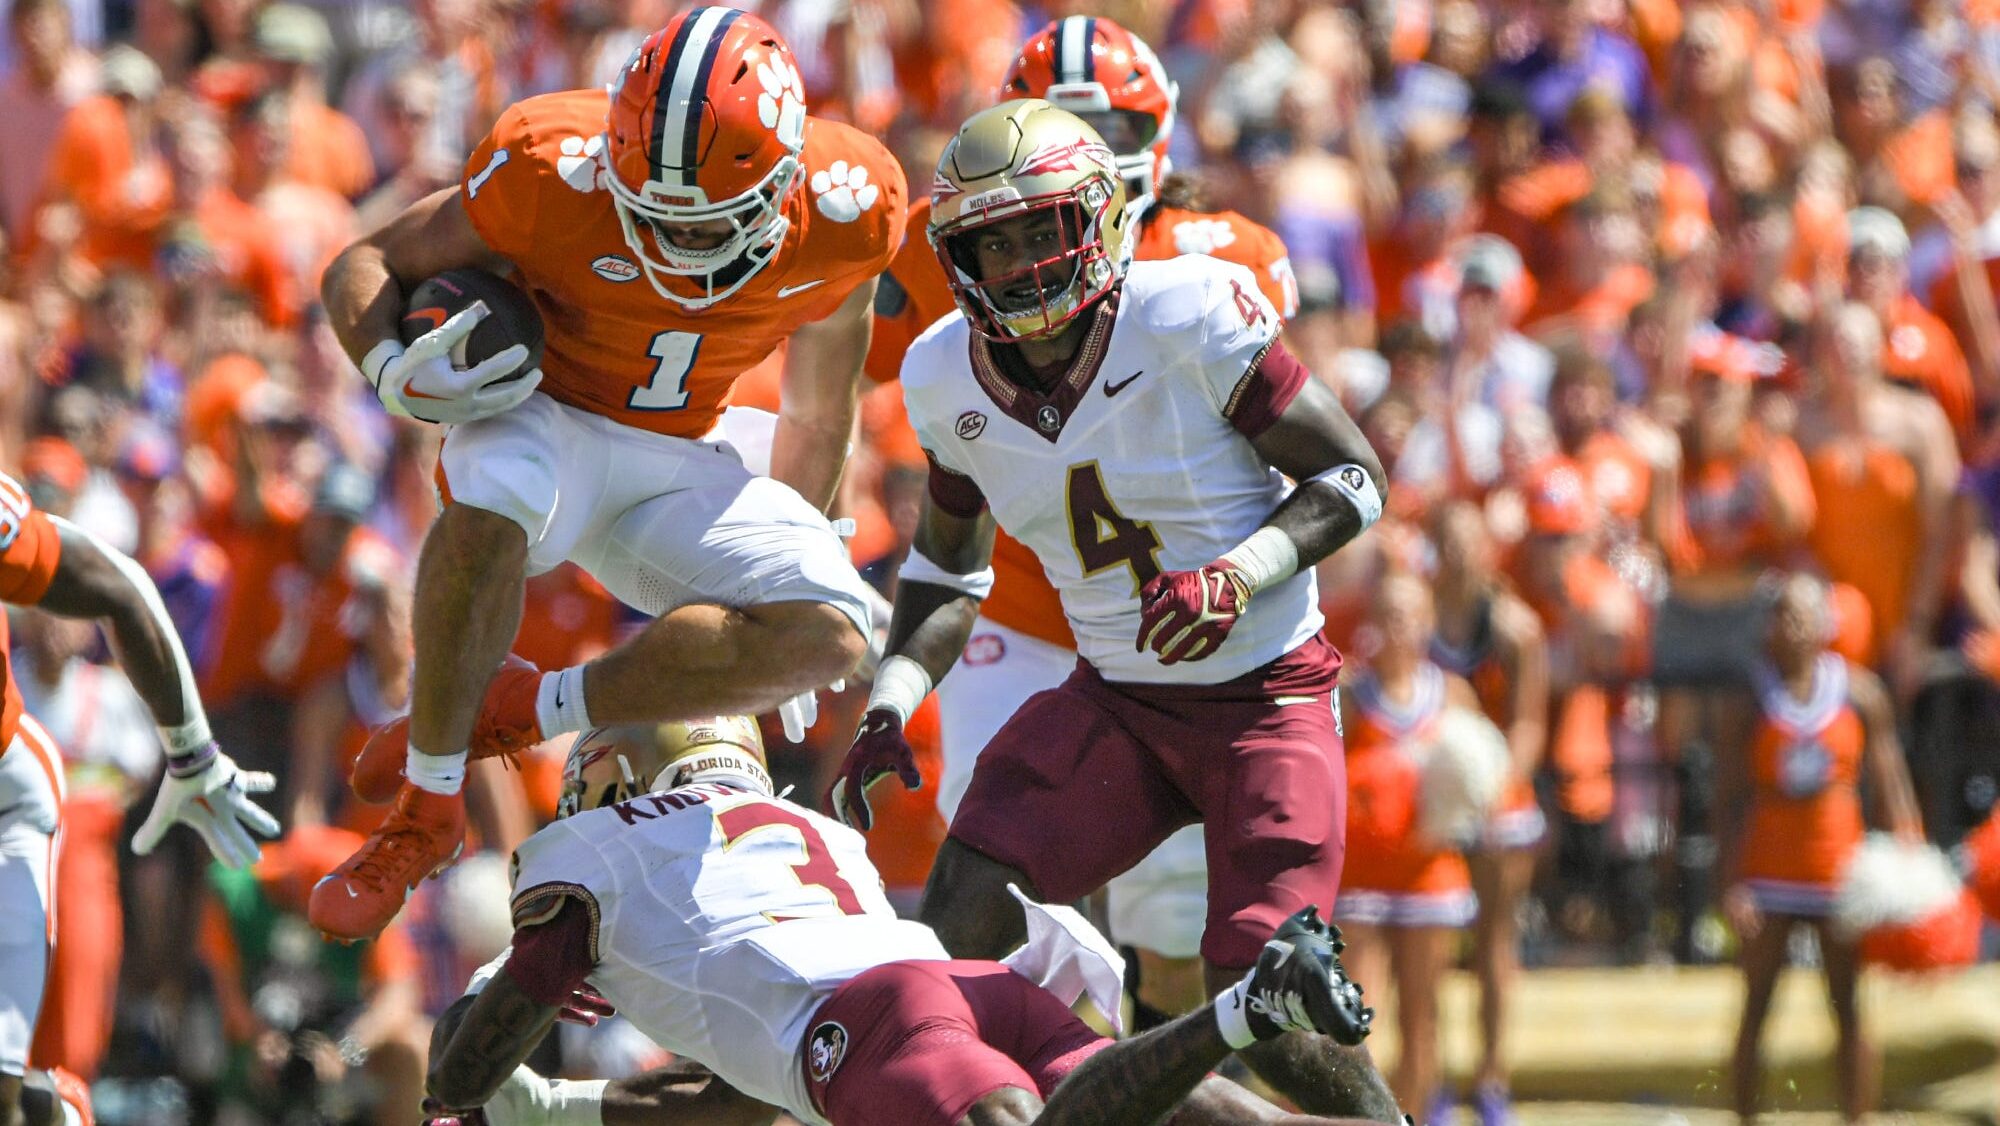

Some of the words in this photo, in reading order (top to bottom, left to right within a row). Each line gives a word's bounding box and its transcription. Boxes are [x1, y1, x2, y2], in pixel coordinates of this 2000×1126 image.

[467, 148, 510, 200] 1
[969, 192, 1006, 210] NOLES
[600, 260, 634, 274] ACC
[1229, 278, 1267, 329] 4
[625, 329, 704, 411] 1
[959, 414, 981, 434] ACC
[1064, 459, 1165, 601] 4
[694, 731, 718, 741] ACC
[680, 757, 742, 776] FLORIDA
[712, 801, 868, 926] 3
